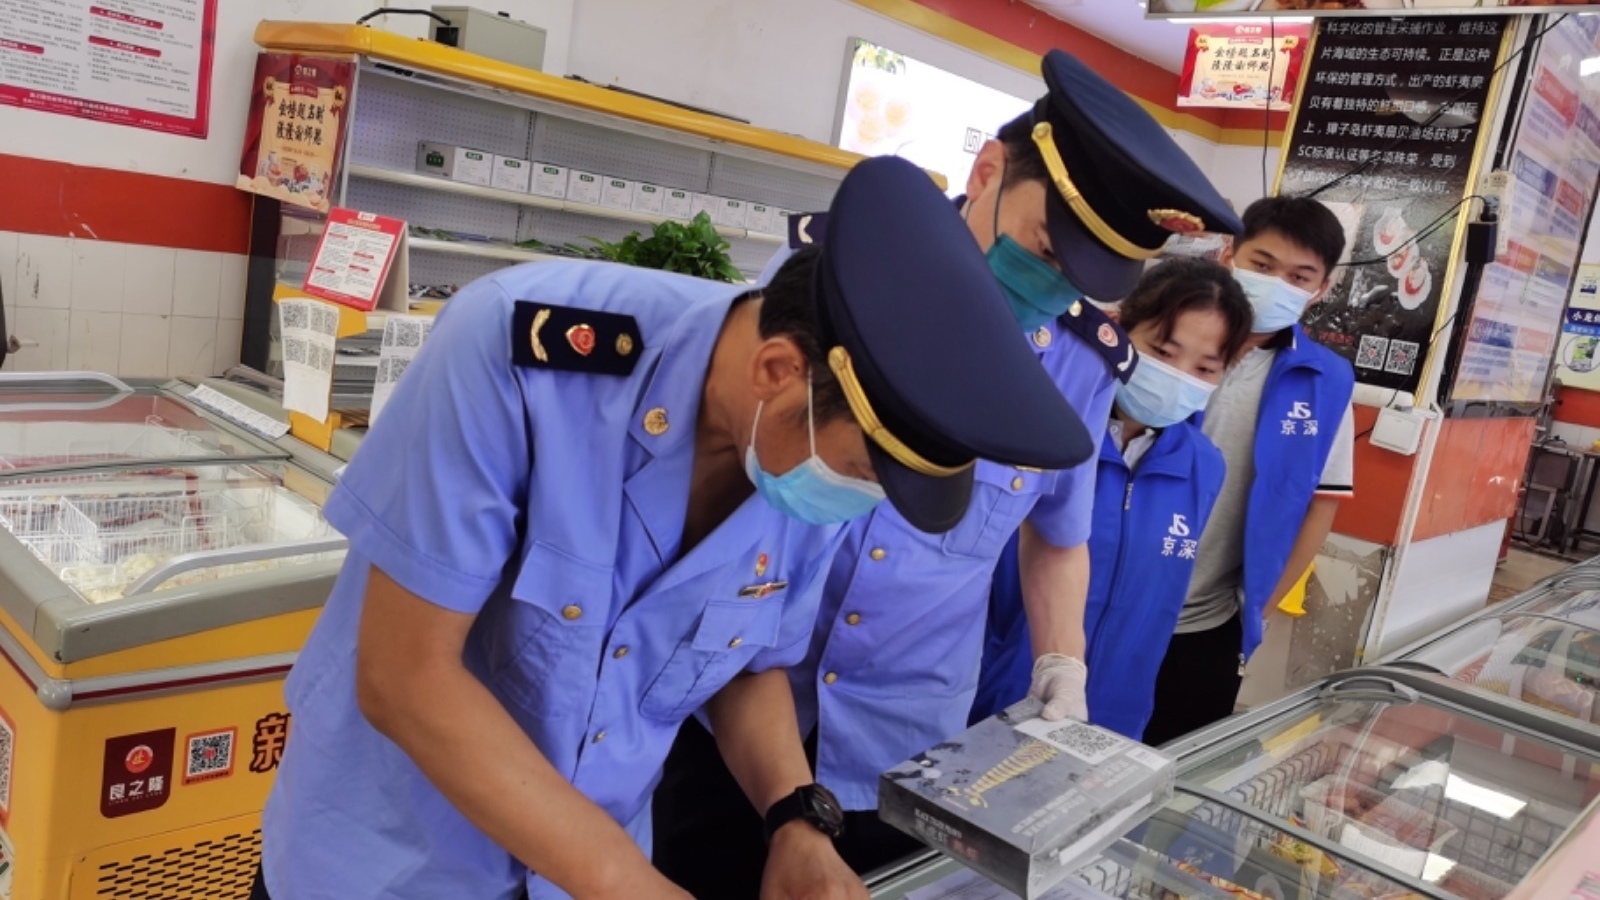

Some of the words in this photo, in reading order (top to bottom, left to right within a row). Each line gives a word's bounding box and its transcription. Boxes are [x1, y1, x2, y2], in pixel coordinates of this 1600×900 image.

[1280, 420, 1318, 435] 京深
[1161, 536, 1197, 559] 京深
[110, 776, 163, 800] 良之隆
